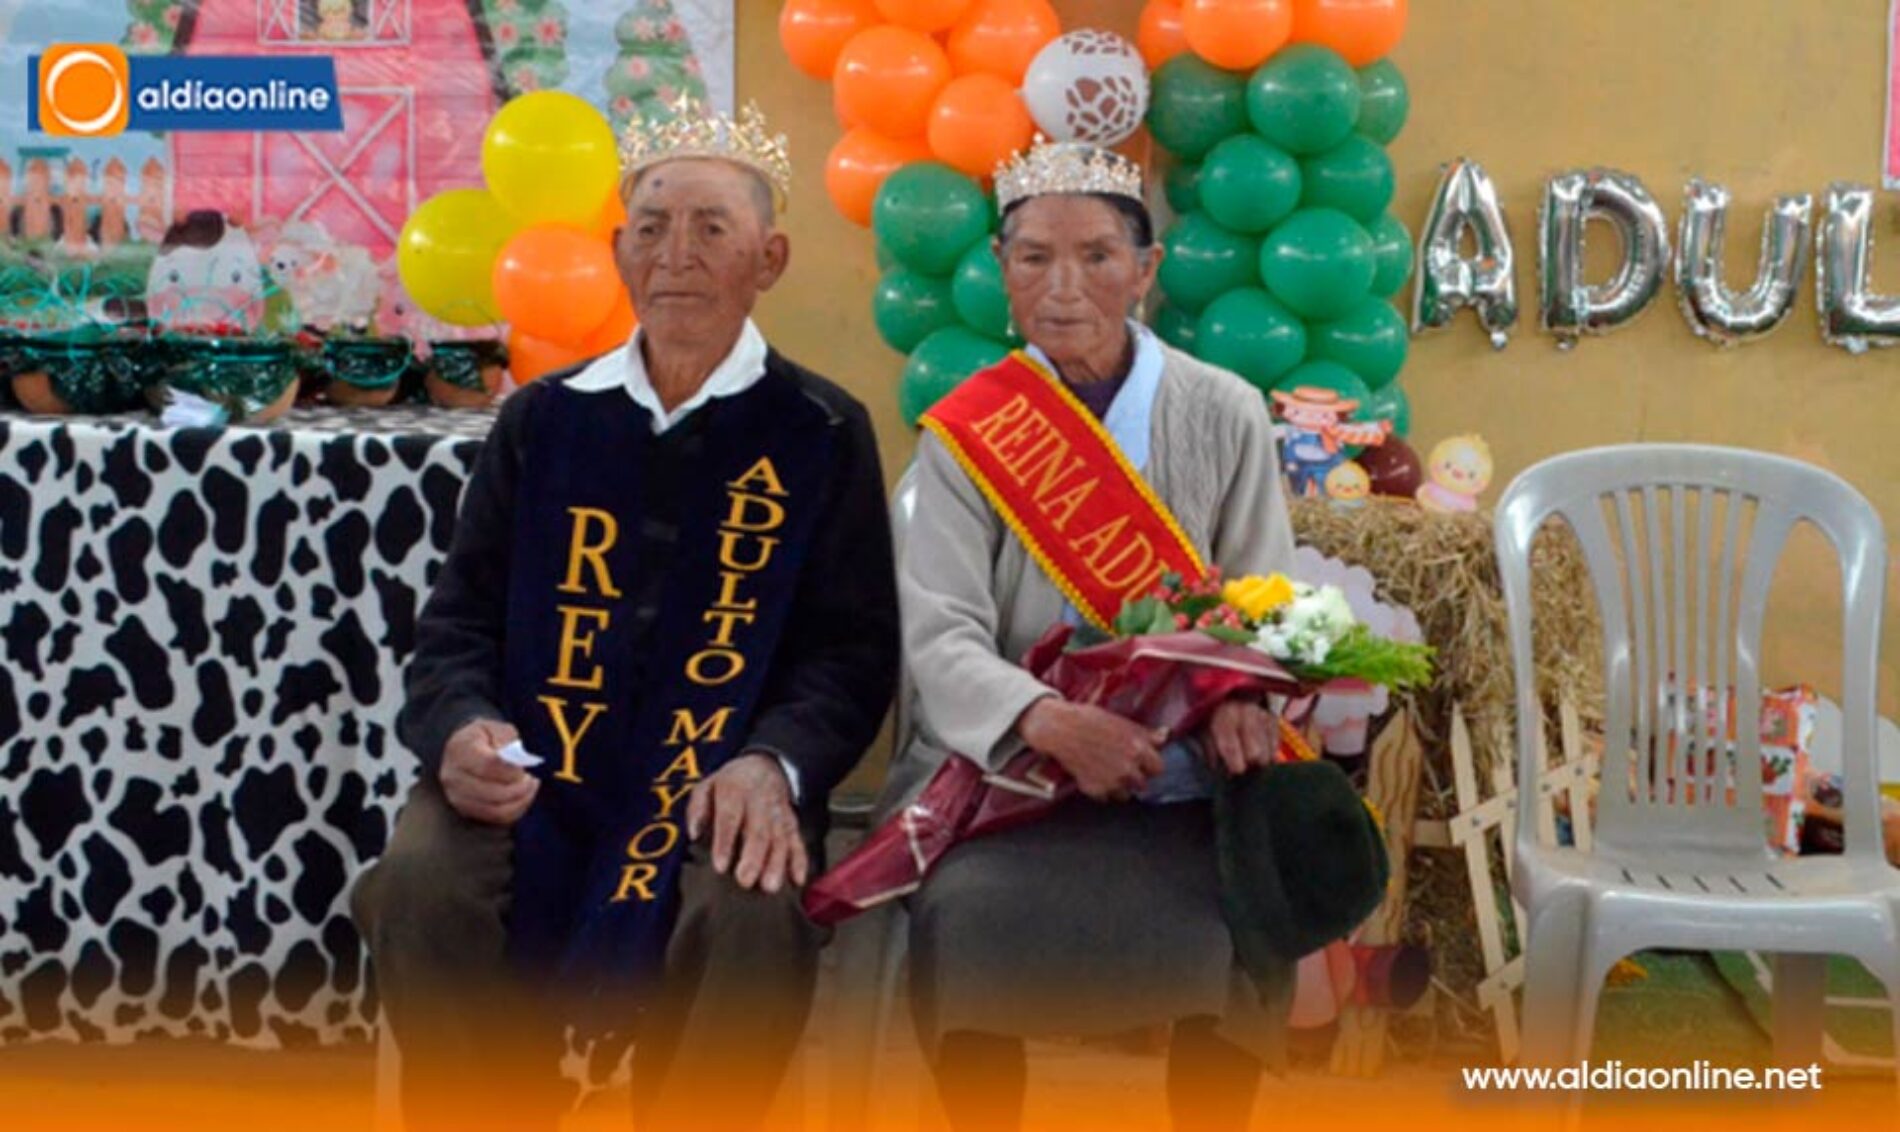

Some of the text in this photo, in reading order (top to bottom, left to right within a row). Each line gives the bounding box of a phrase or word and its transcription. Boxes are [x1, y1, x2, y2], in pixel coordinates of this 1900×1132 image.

[970, 393, 1099, 532] REINA
[537, 506, 623, 784] REY
[610, 455, 790, 903] ADULTO MAYOR
